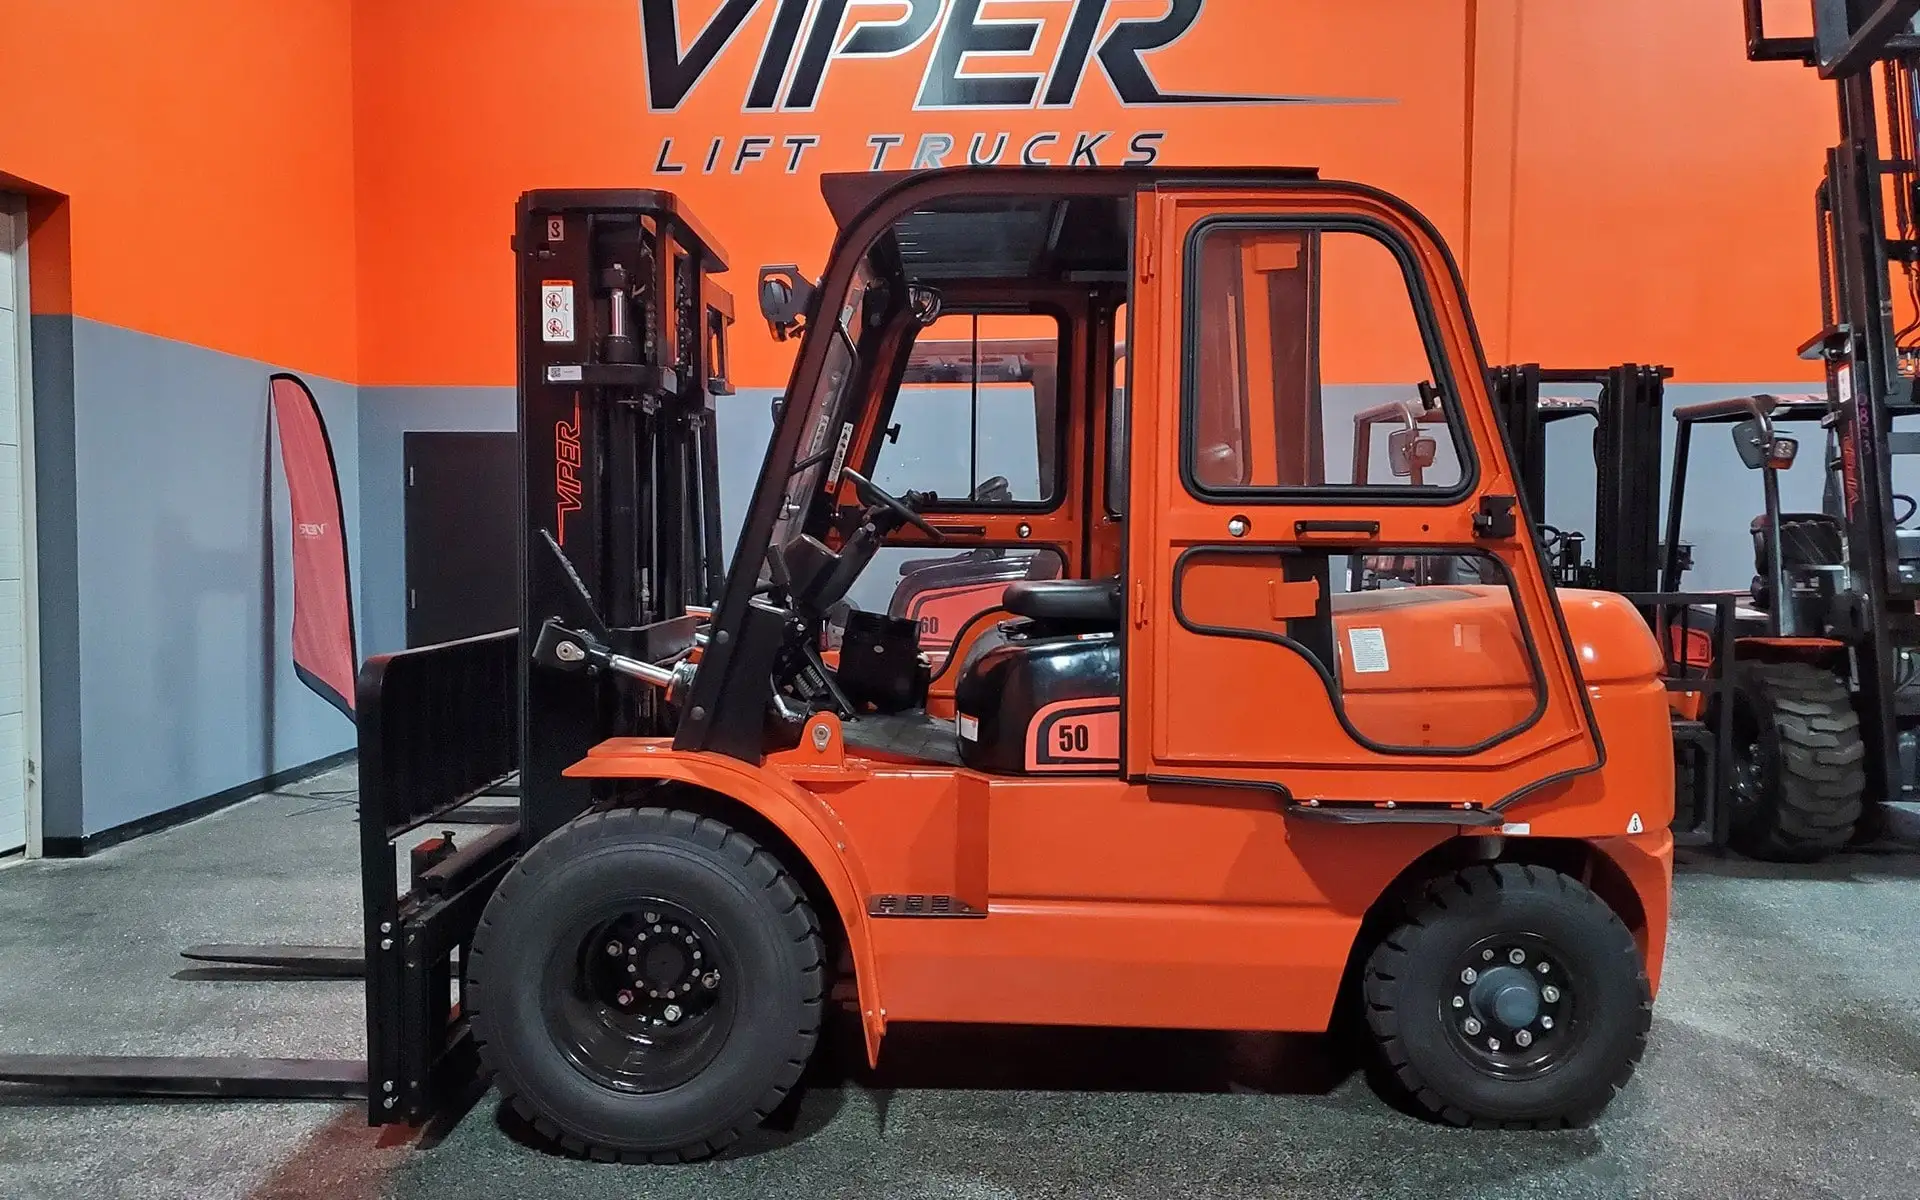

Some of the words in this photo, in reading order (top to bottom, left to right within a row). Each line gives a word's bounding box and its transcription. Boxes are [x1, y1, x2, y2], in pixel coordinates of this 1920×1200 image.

[640, 0, 1395, 113] VIPER
[652, 134, 820, 175] LIFT
[866, 131, 1168, 171] TRUCKS
[556, 392, 581, 545] VIPER
[920, 616, 938, 634] 60
[1059, 725, 1088, 751] 50
